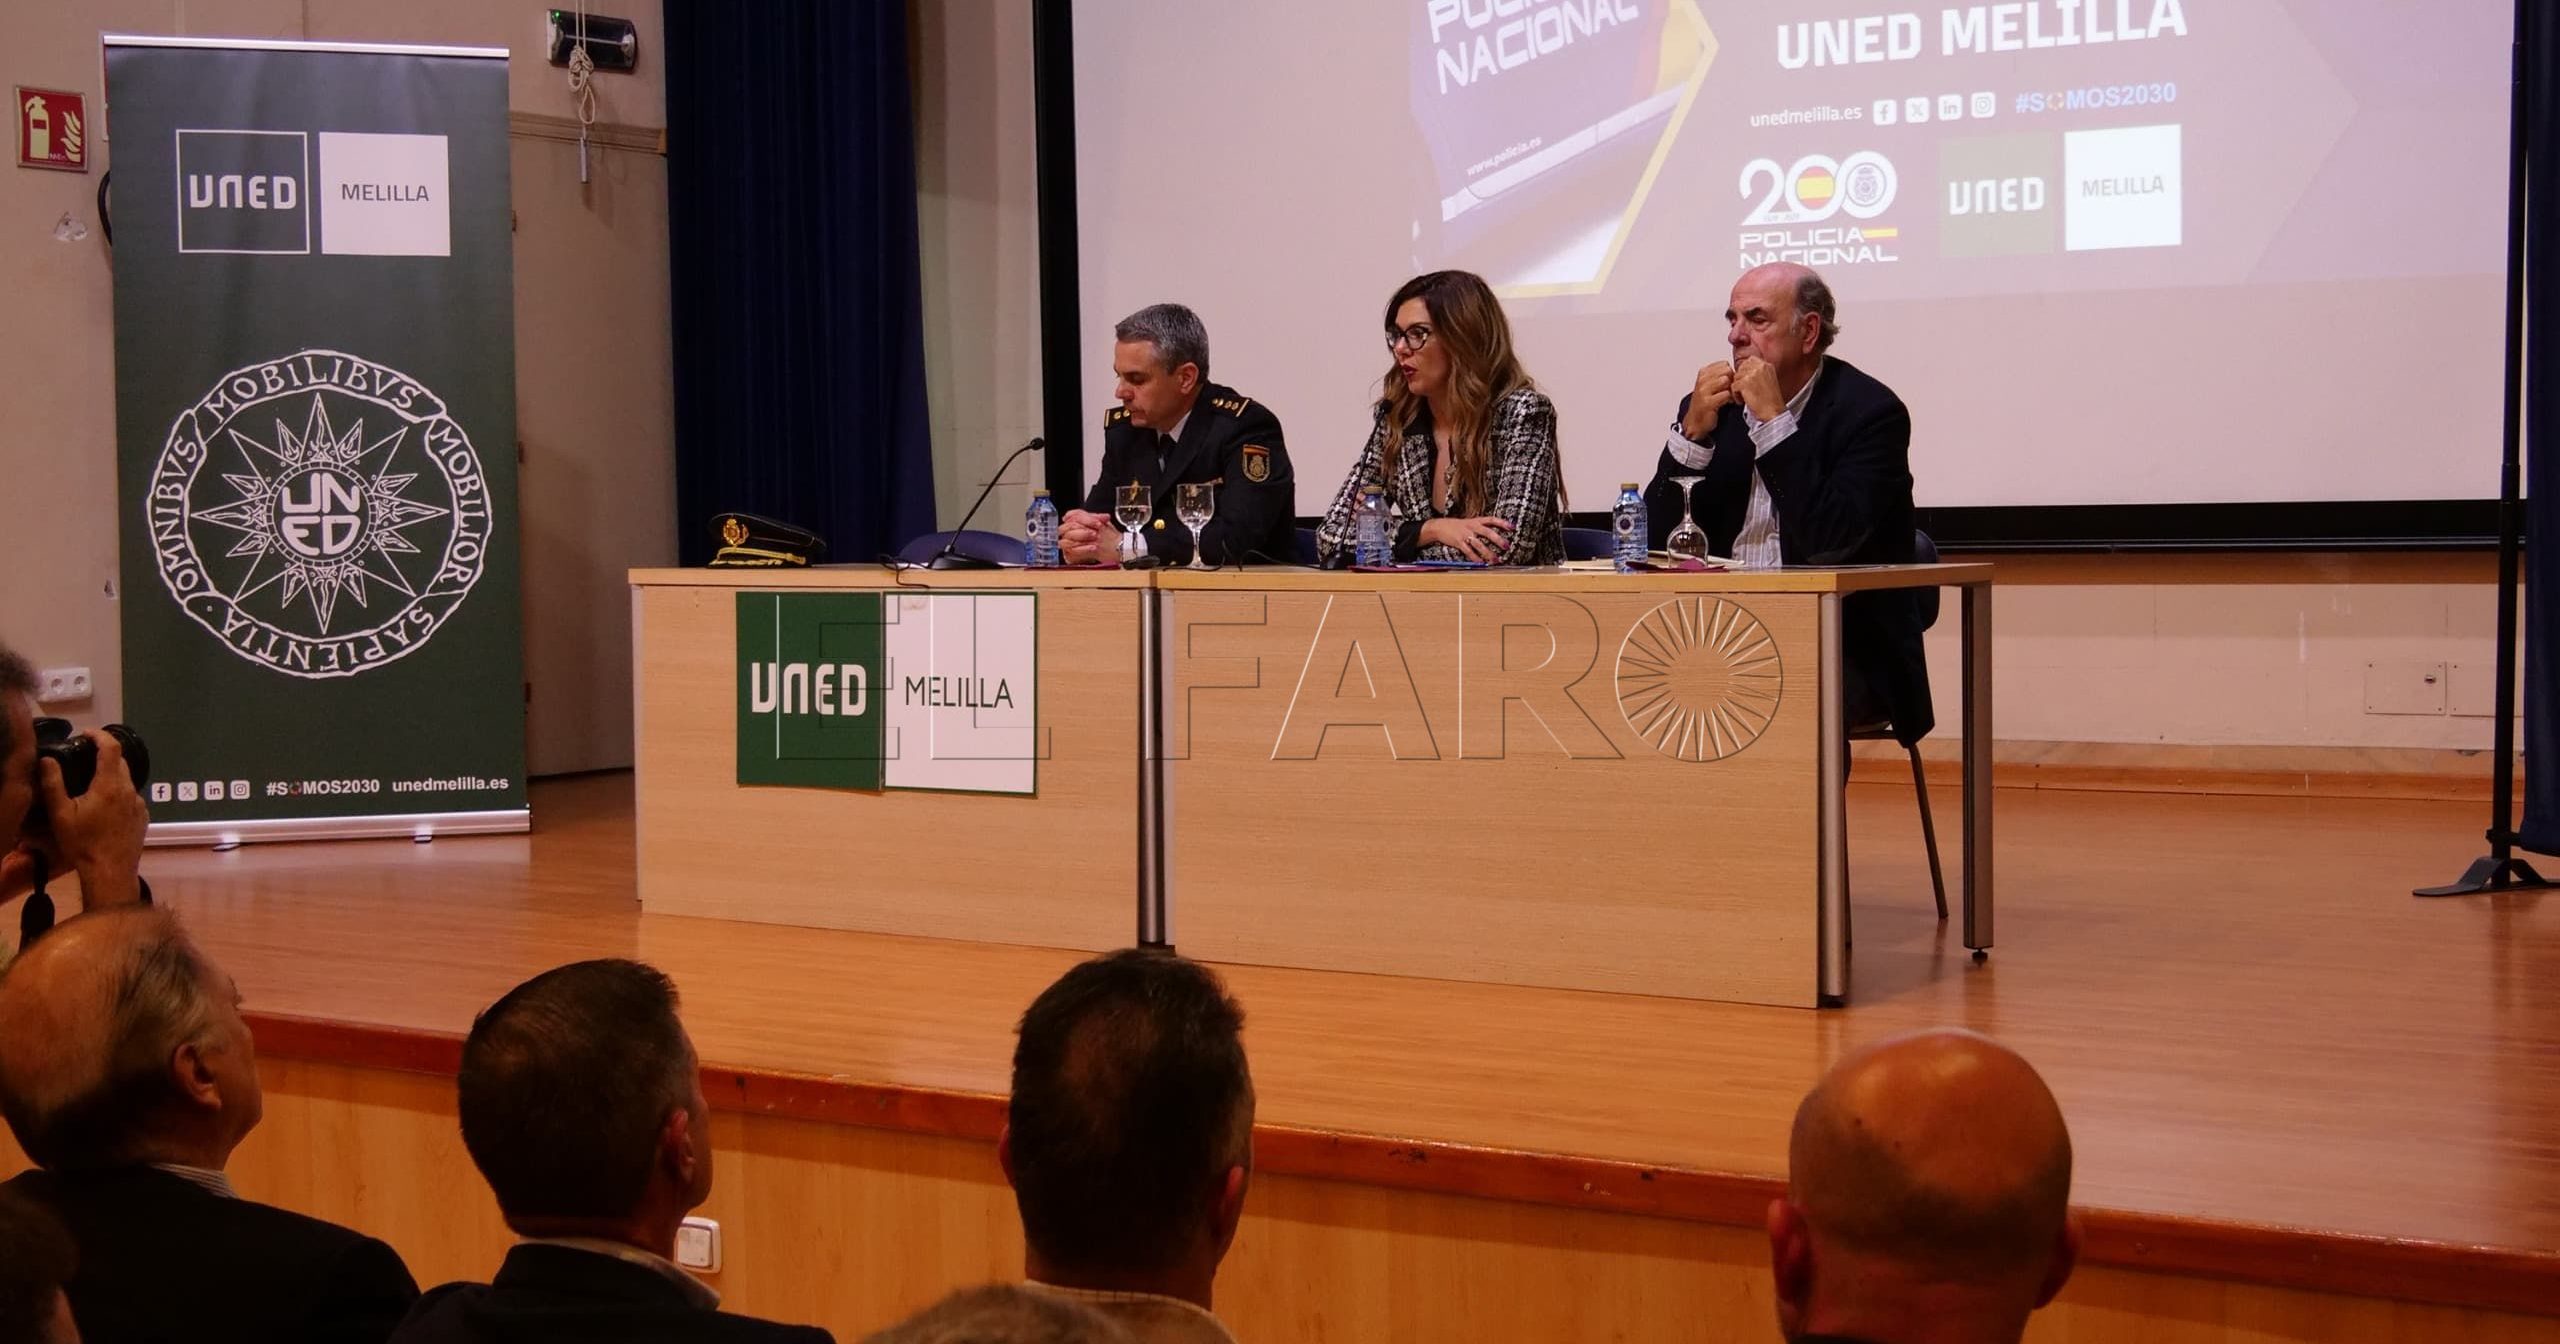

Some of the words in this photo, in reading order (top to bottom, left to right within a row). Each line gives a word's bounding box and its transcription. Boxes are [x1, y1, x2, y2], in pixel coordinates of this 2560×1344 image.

[1436, 0, 1640, 95] NACIONAL
[1776, 13, 1922, 70] UNED
[1941, 0, 2189, 56] MELILLA
[1750, 104, 1863, 128] unedmelilla.es
[189, 174, 297, 210] UNED
[341, 183, 430, 202] MELILLA
[1739, 150, 1898, 226] 200
[1949, 176, 2045, 216] UNED
[2081, 175, 2165, 199] MELILLA
[1739, 227, 1865, 250] POLICIA
[1739, 245, 1899, 269] NACIONAL
[204, 355, 421, 424] MOBILIBVS
[155, 436, 199, 592] OMNIBVS
[429, 425, 486, 583] MOBILIOR
[221, 605, 435, 672] SAPIENTIA
[751, 662, 867, 717] UNED
[905, 675, 1015, 709] MELILLA
[392, 776, 510, 793] unedmelilla.es
